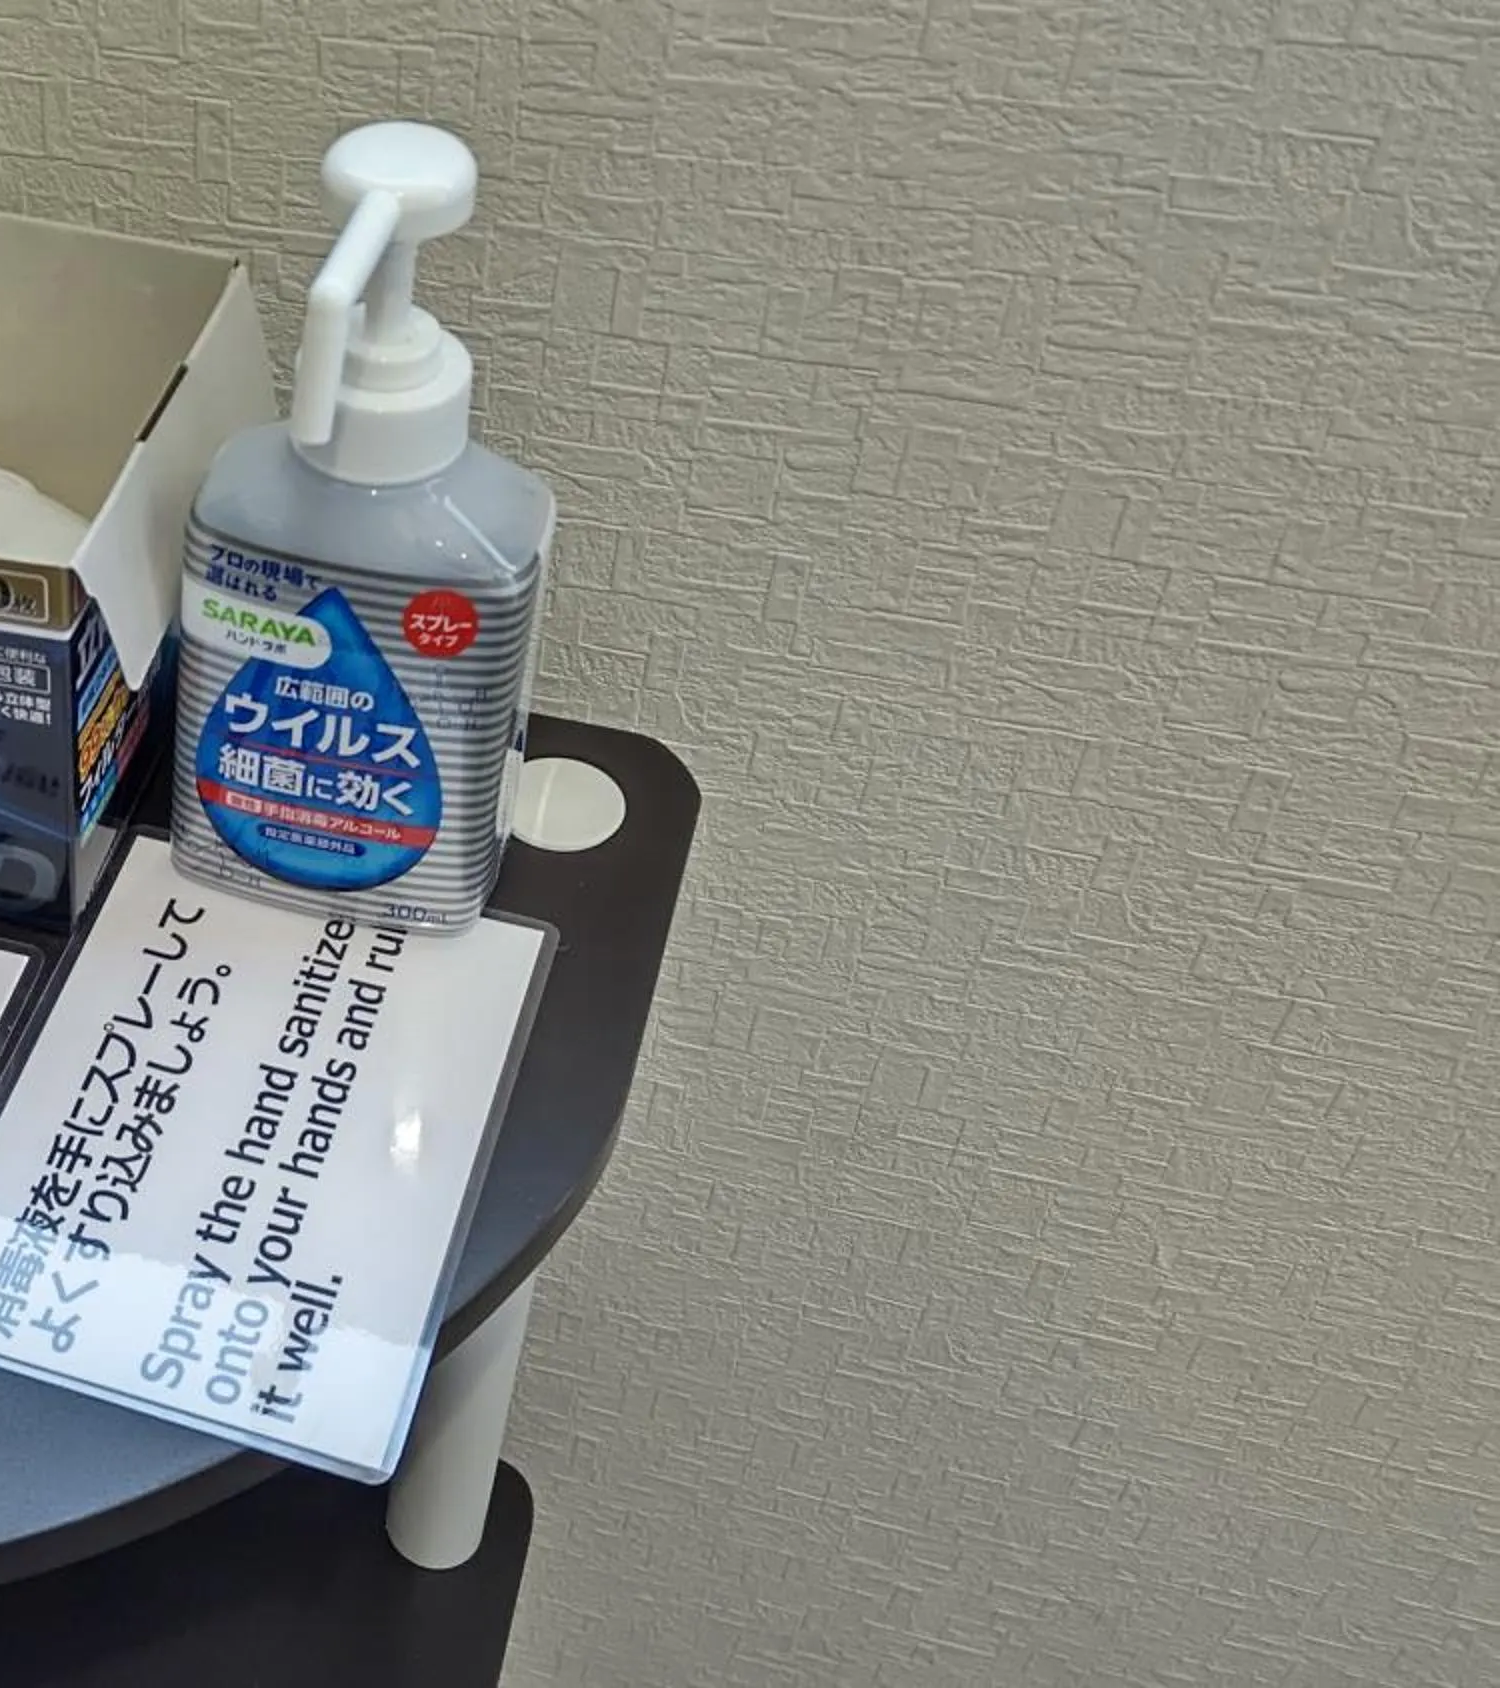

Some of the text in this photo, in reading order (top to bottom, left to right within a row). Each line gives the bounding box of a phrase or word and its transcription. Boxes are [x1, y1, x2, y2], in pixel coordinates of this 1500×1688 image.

[204, 564, 278, 602] 選ばれる
[210, 543, 322, 590] プロの現場で
[201, 598, 316, 648] SARAYA
[409, 613, 473, 633] スプレー
[418, 632, 459, 648] タイプ
[274, 675, 375, 713] 広範囲の
[224, 690, 421, 770] ウイルス
[217, 742, 415, 818] 細菌に効く
[29, 964, 232, 1353] よくすり込みましょう。
[140, 912, 357, 1389] Spray the hand sanitize
[205, 1299, 269, 1405] onto
[247, 1186, 308, 1288] your
[278, 1057, 357, 1178] hands
[336, 979, 387, 1050] and
[250, 1275, 343, 1424] it well.
